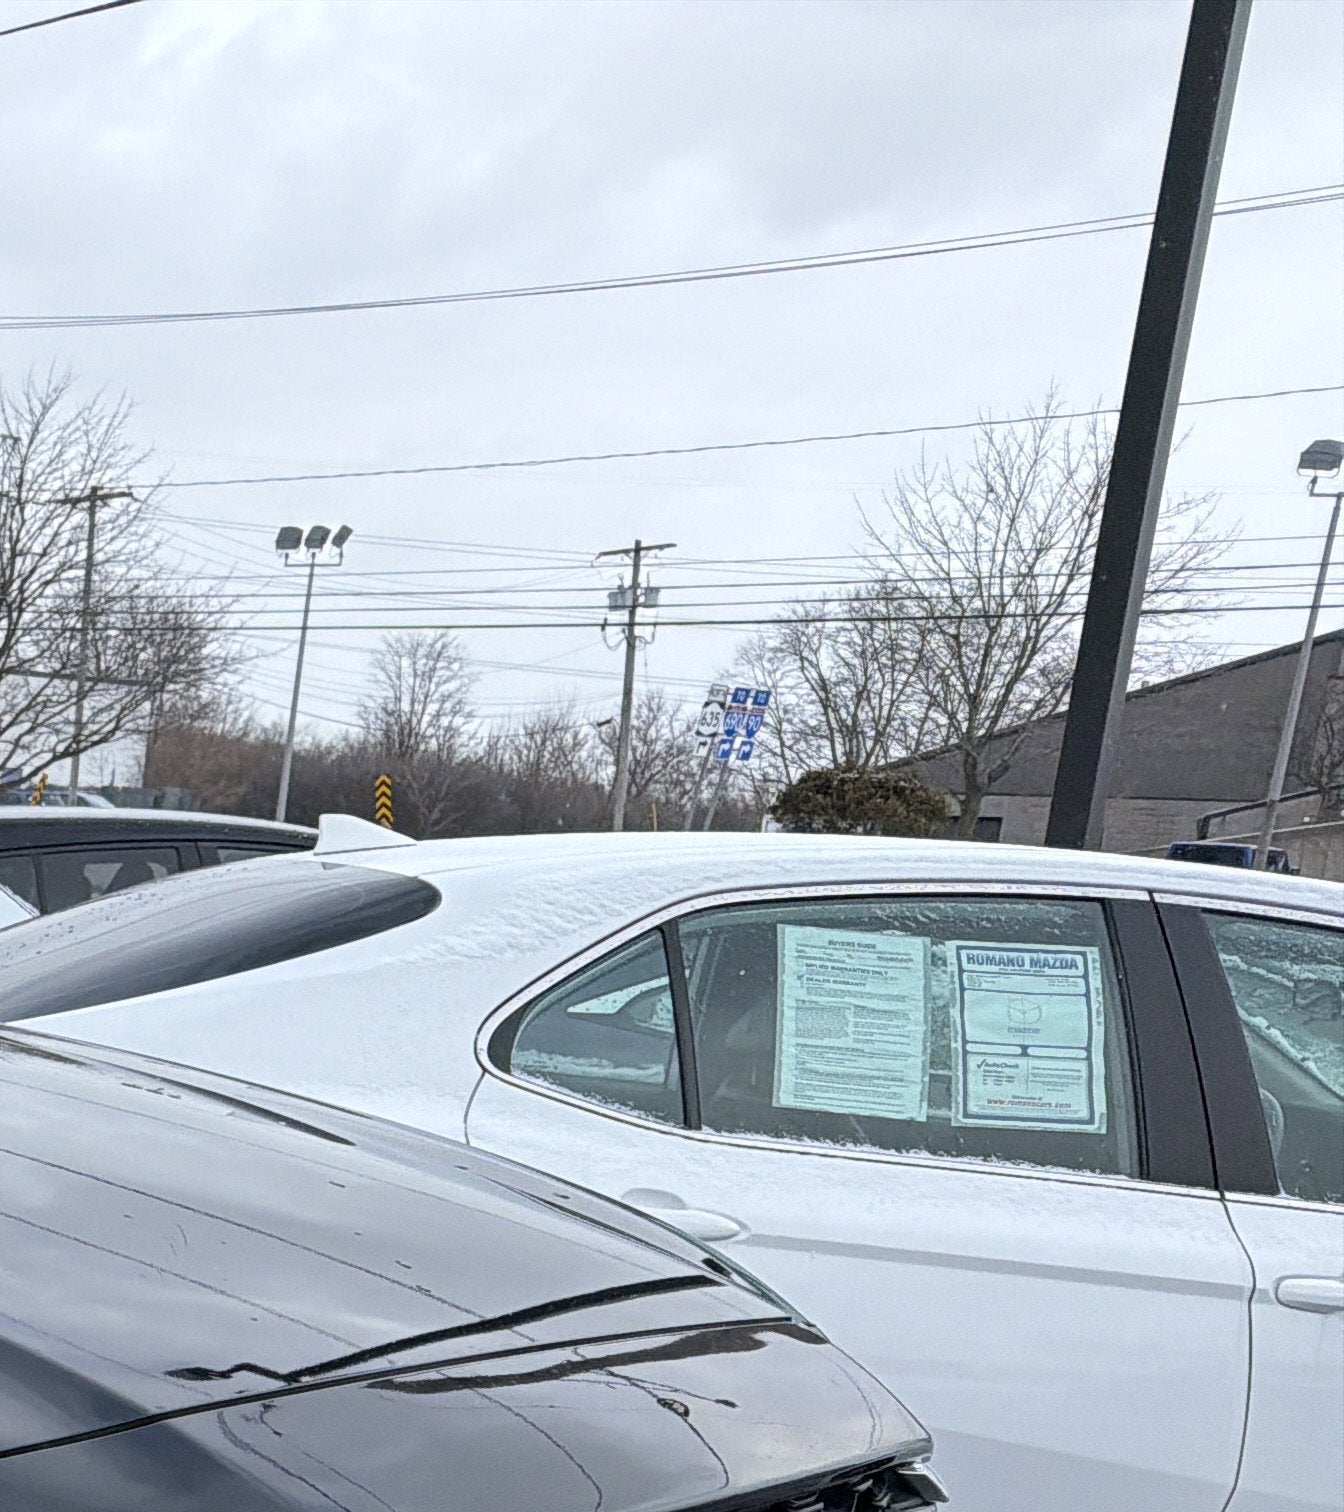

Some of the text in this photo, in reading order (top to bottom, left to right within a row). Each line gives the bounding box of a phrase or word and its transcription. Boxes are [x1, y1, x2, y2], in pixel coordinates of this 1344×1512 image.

[700, 711, 721, 728] 635
[725, 712, 743, 731] 690
[748, 715, 761, 731] 90
[966, 952, 1079, 970] ROMANO MAZDA
